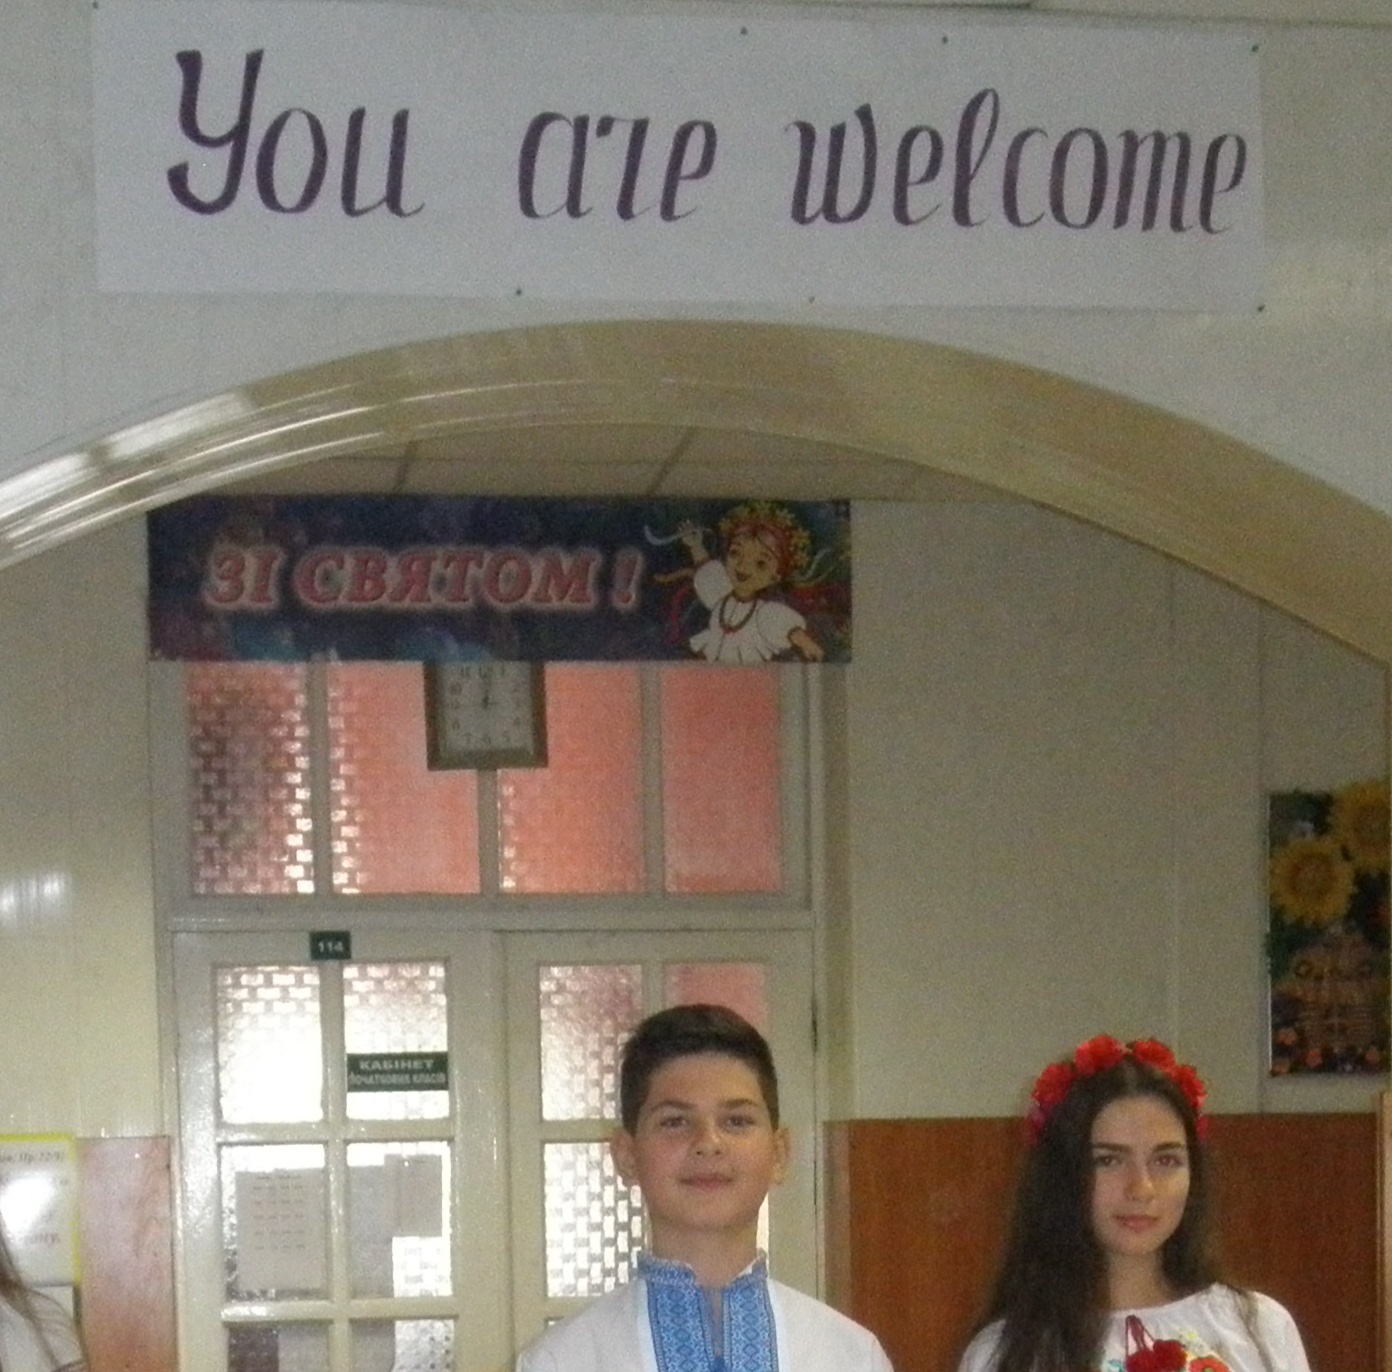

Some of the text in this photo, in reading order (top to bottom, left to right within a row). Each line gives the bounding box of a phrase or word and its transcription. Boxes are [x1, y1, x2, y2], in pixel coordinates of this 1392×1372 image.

[164, 48, 1249, 236] You are welcome
[318, 941, 344, 953] 114
[359, 1059, 435, 1071] КАБІНЕТ
